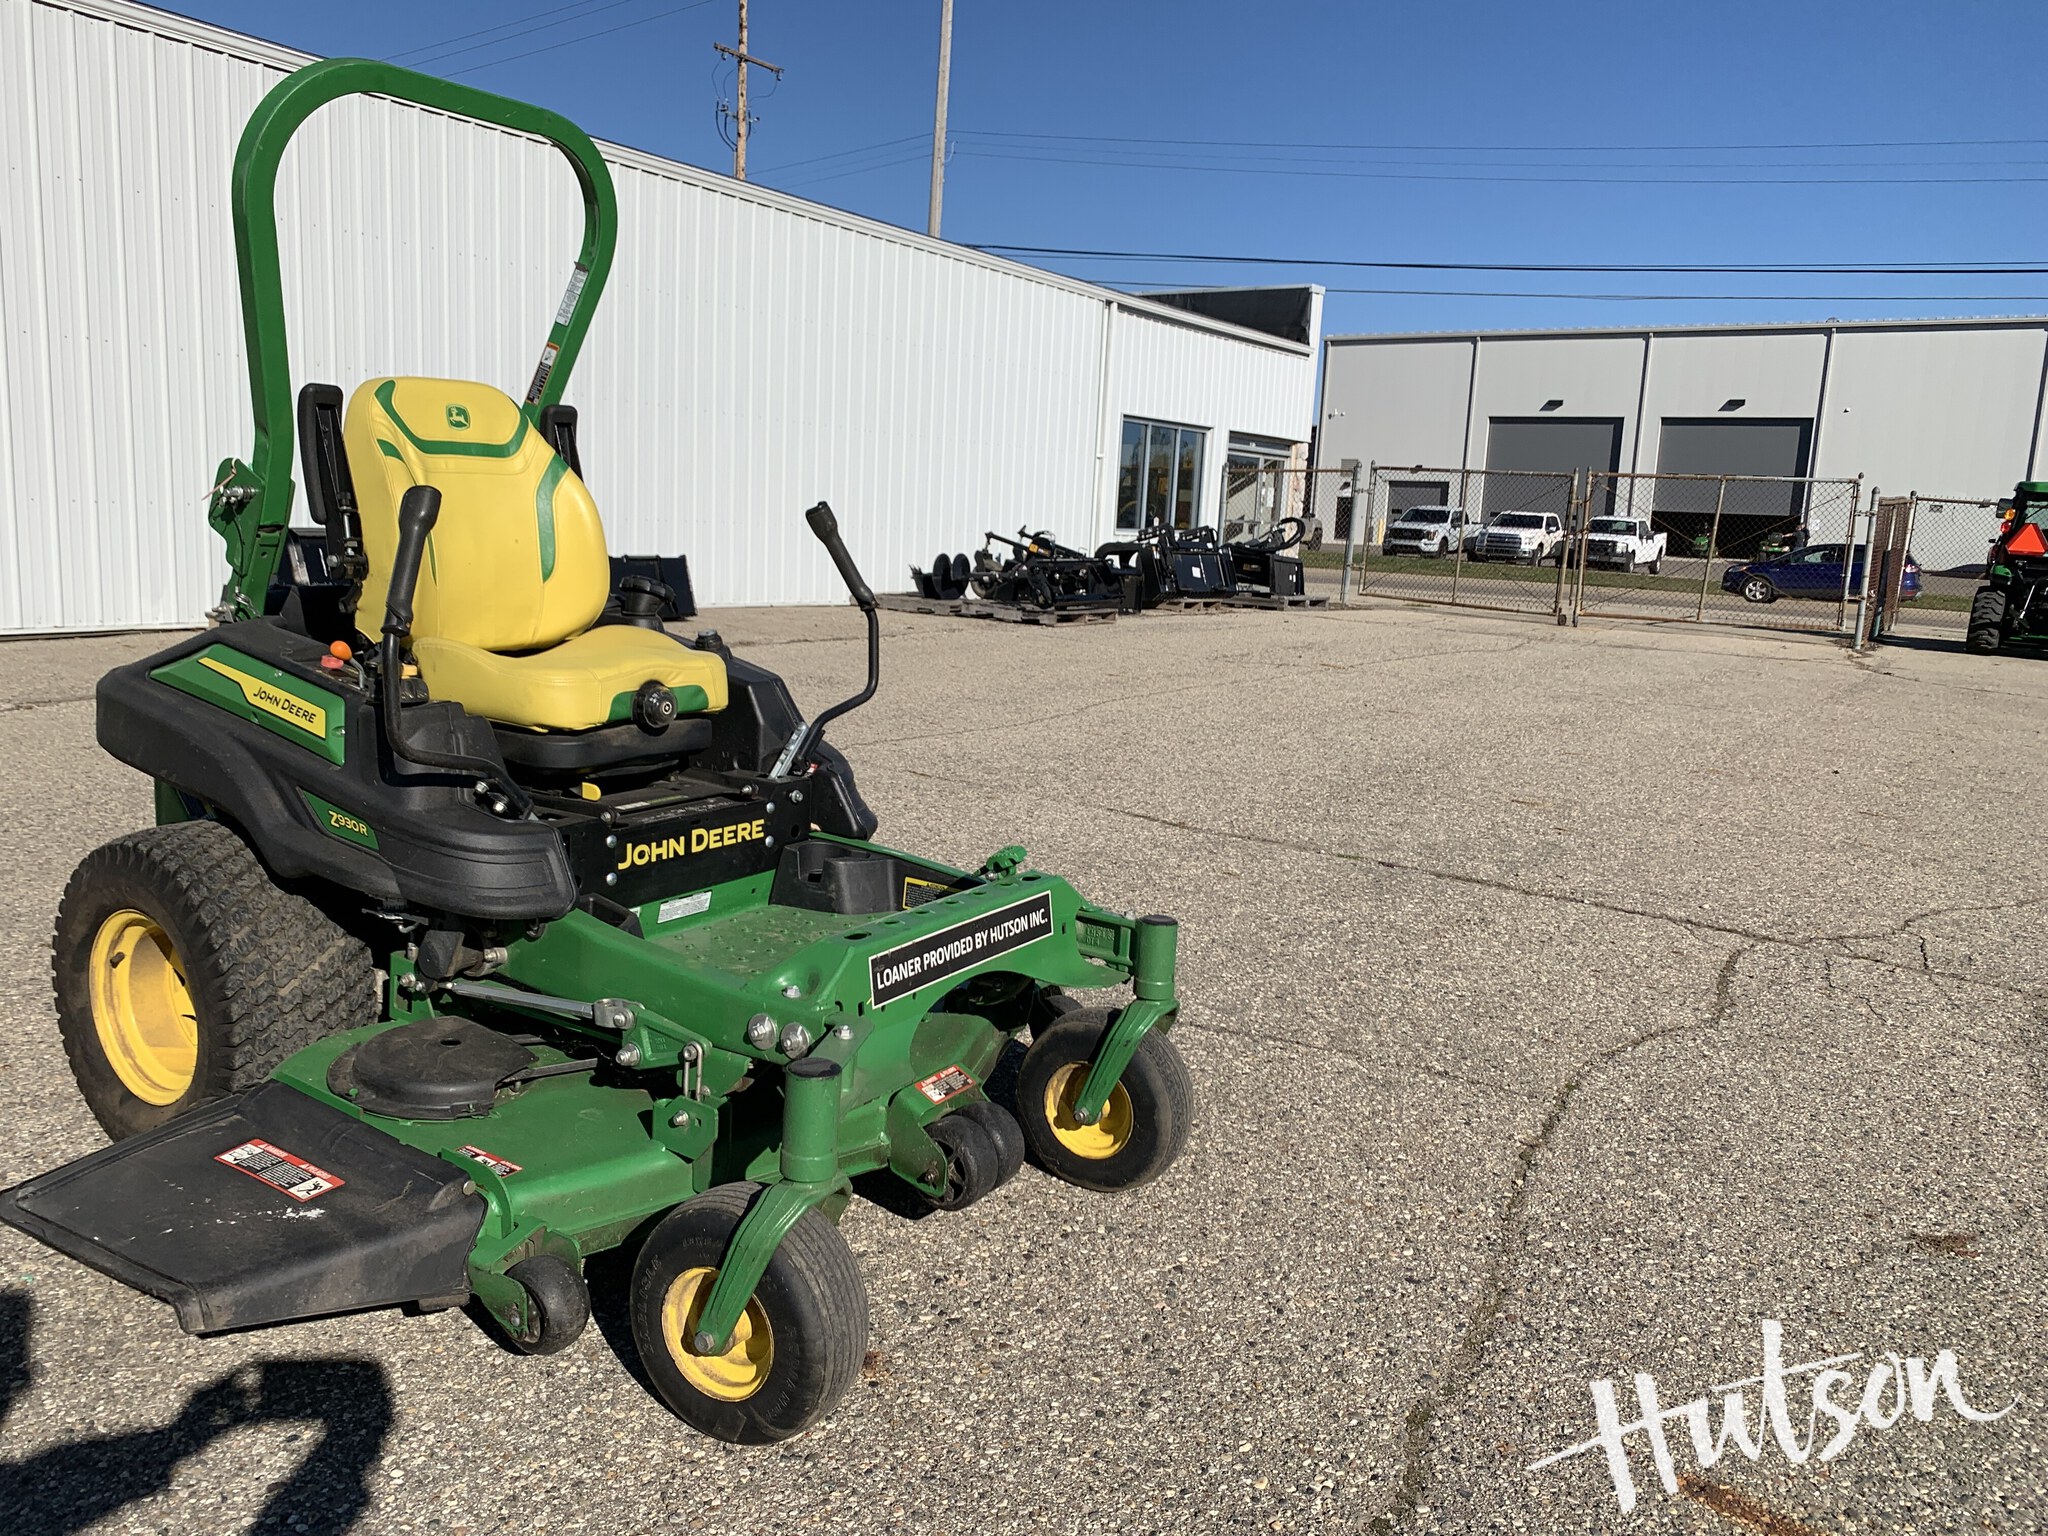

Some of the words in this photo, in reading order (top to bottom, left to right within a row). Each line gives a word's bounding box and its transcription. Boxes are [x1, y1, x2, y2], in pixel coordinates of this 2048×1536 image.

[253, 687, 281, 707] JOHN
[281, 700, 317, 724] DEERE
[328, 810, 368, 837] Z930R
[618, 835, 685, 870] JOHN
[691, 819, 765, 853] DEERE
[876, 958, 922, 990] LOANER
[923, 936, 973, 971] PROVIDED
[975, 931, 989, 949] BY
[989, 915, 1029, 944] HUTSON
[1029, 908, 1048, 928] INC.
